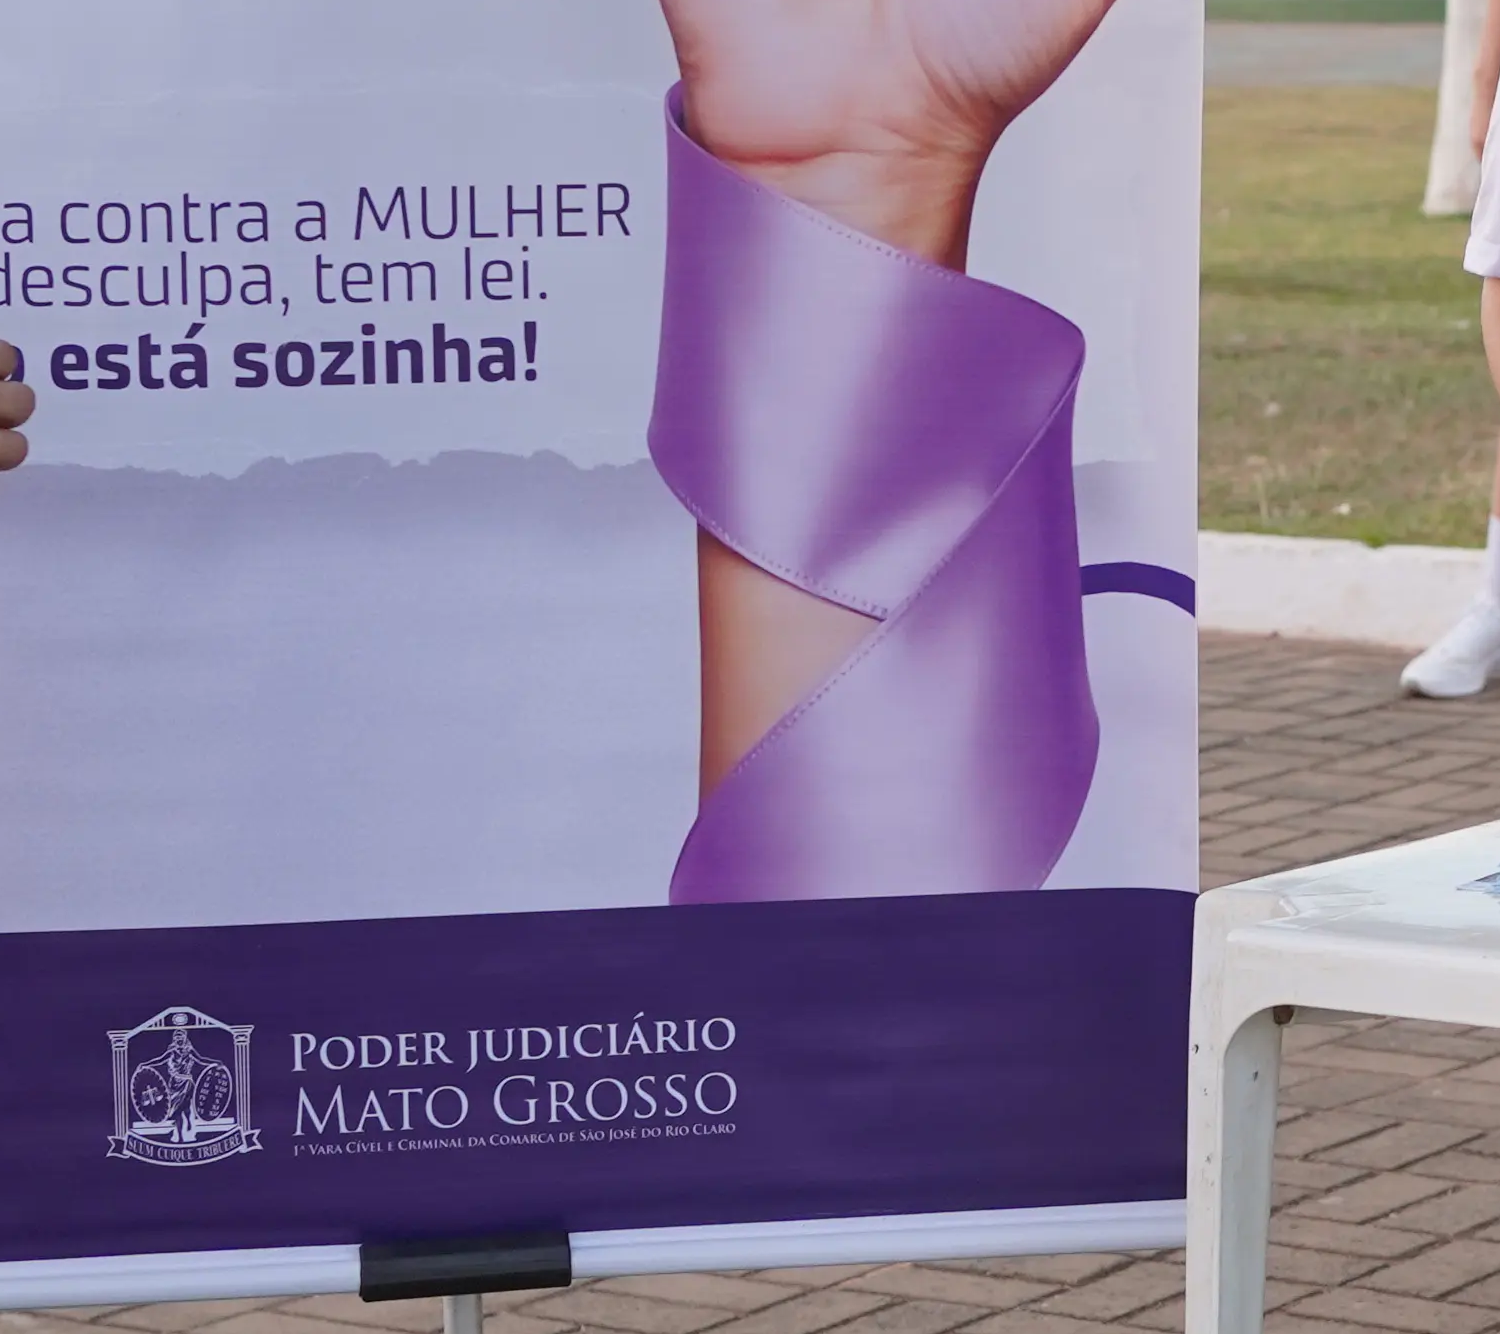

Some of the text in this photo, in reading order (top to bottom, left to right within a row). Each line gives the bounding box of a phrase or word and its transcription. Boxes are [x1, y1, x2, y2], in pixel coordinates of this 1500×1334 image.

[60, 191, 271, 245] contra
[294, 199, 328, 242] a
[355, 182, 634, 242] MULHER
[313, 253, 438, 305] tem
[465, 246, 549, 303] lei.
[49, 322, 211, 391] está
[232, 320, 541, 390] sozinha!
[290, 1011, 737, 1072] PODER JUDICIÁRIO
[292, 1084, 469, 1137] MATO
[493, 1070, 739, 1128] GROSSO
[308, 1142, 344, 1156] VARA
[345, 1138, 384, 1154] CÍVEL
[387, 1140, 396, 1153] E
[397, 1136, 465, 1152] CRIMINAL
[467, 1135, 487, 1149] DA
[488, 1131, 556, 1148] COMARCA
[558, 1131, 576, 1144] DE
[578, 1127, 605, 1142] SÃO
[608, 1126, 637, 1144] JOSÉ
[641, 1126, 662, 1139] DO
[664, 1124, 691, 1138] RIO
[692, 1122, 737, 1136] CLARO
